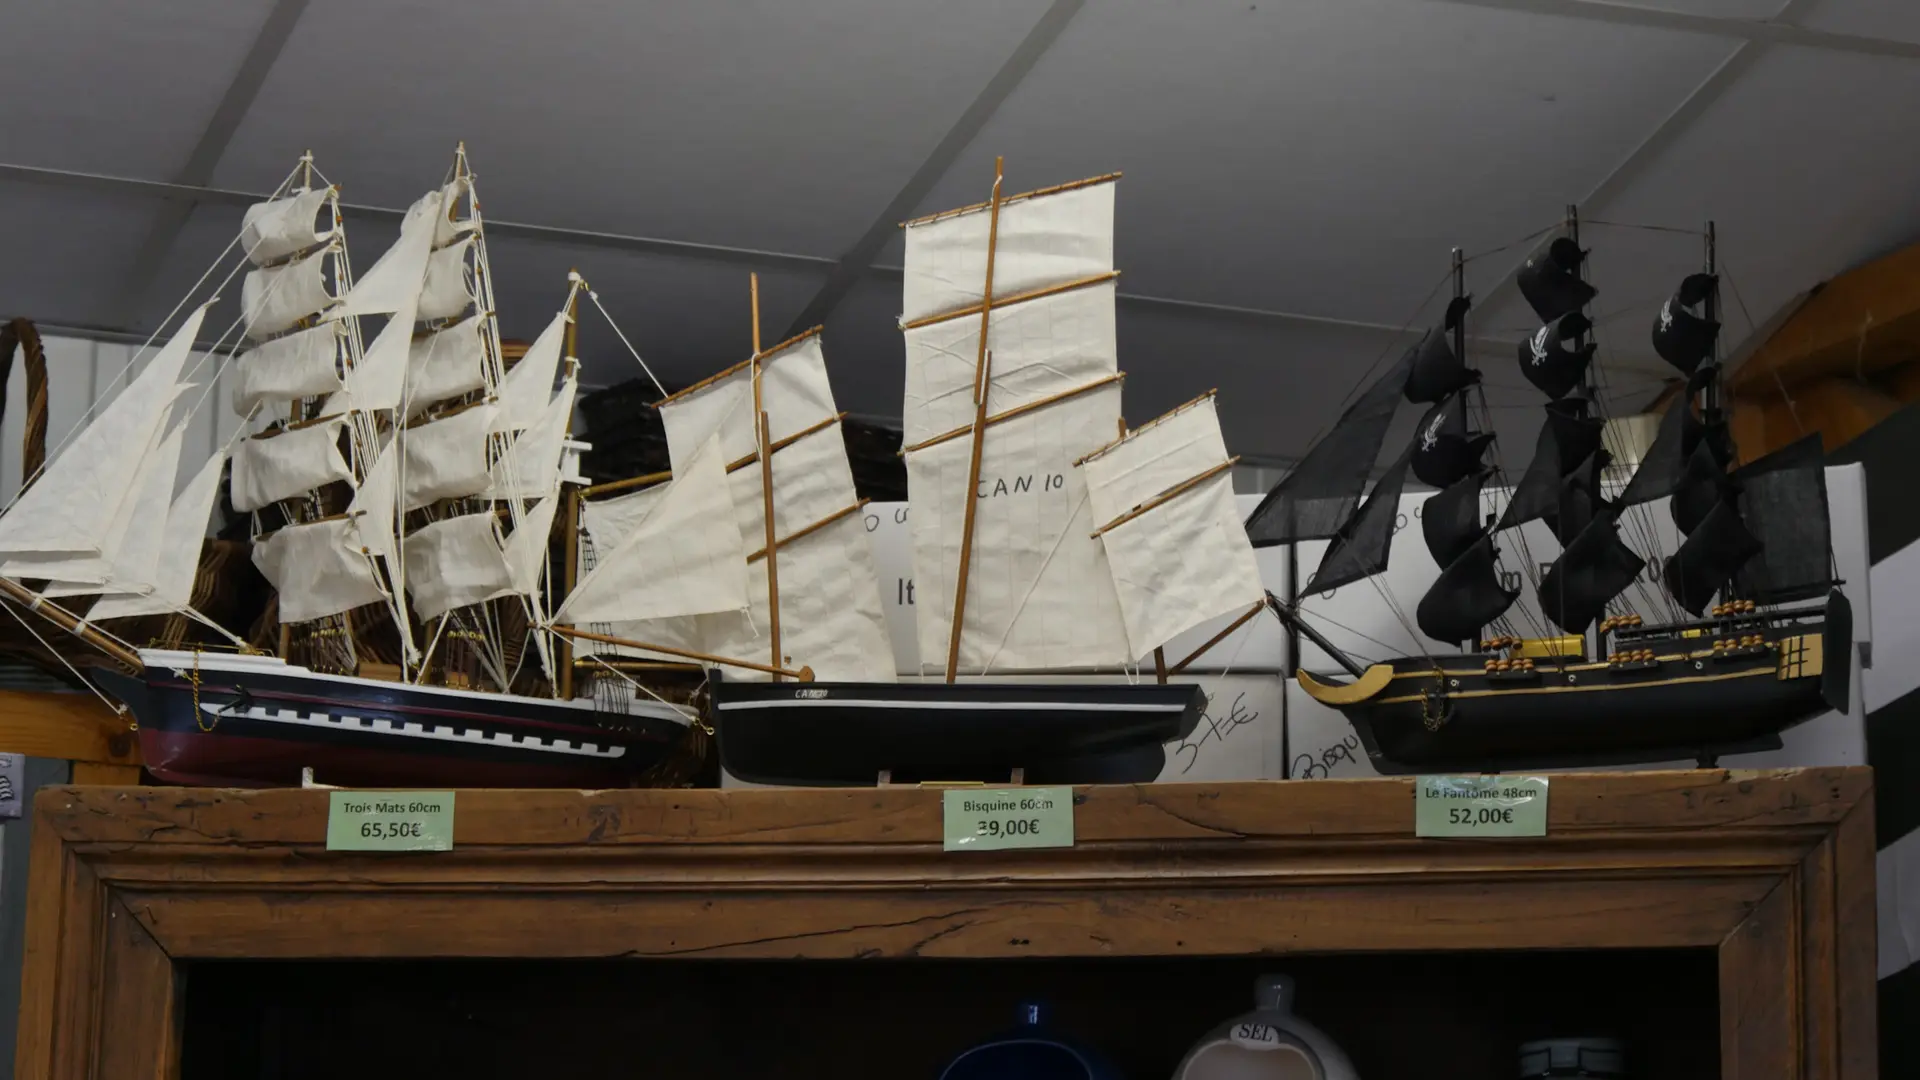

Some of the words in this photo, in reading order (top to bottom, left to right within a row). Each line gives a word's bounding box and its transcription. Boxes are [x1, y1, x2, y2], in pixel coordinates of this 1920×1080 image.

[1425, 787, 1440, 799] Le
[1443, 786, 1499, 799] Fantôme
[1502, 787, 1537, 799] 48cm
[343, 802, 372, 813] Trois
[375, 802, 405, 813] Mats
[408, 802, 441, 813] 60cm
[963, 800, 1016, 813] Bisquine
[1020, 799, 1053, 810] 60cm
[1449, 808, 1514, 827] 52,00€
[361, 822, 421, 840] 65,50€
[977, 819, 1040, 839] 39,00€
[1238, 1023, 1273, 1042] SEL
